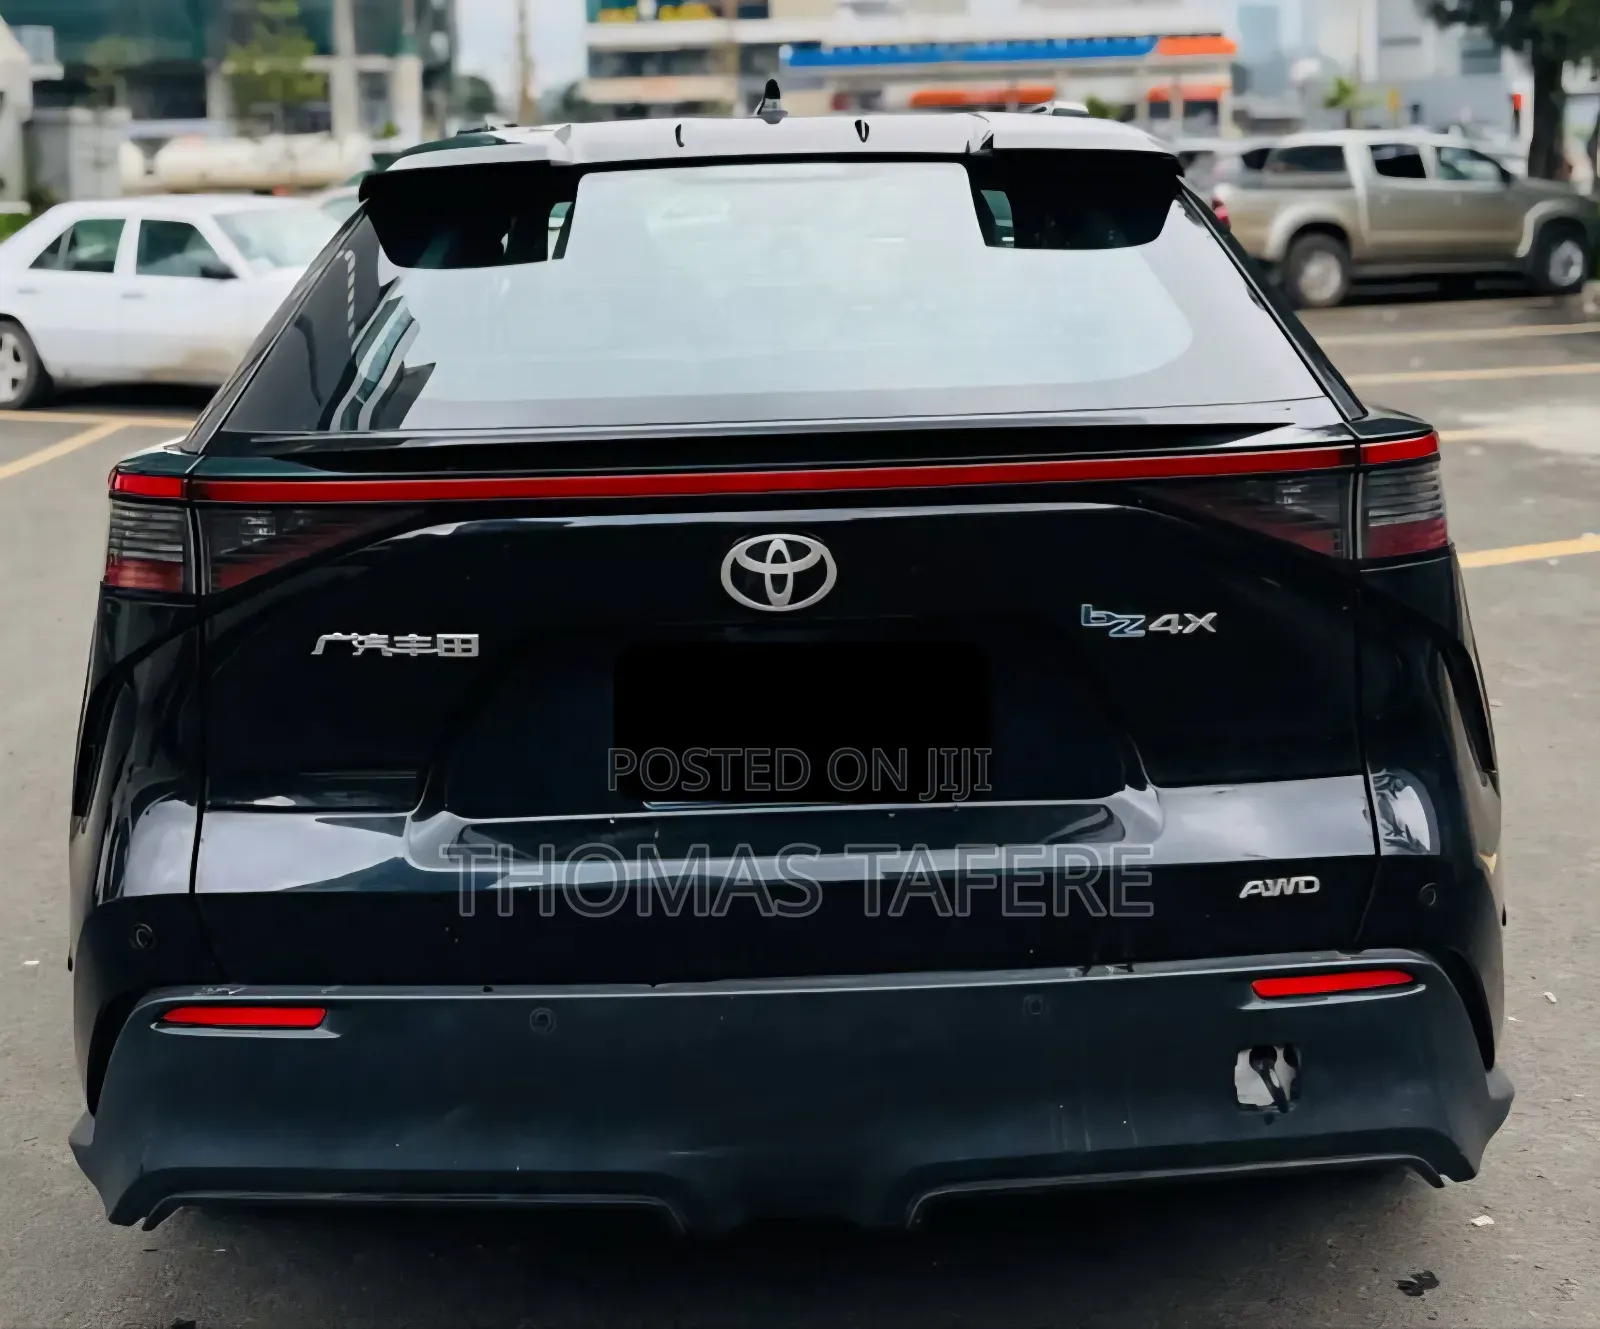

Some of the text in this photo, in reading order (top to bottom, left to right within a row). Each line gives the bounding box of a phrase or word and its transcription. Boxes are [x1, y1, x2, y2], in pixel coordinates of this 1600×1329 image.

[310, 632, 479, 657] 广汽丰田
[1239, 875, 1321, 899] AWD
